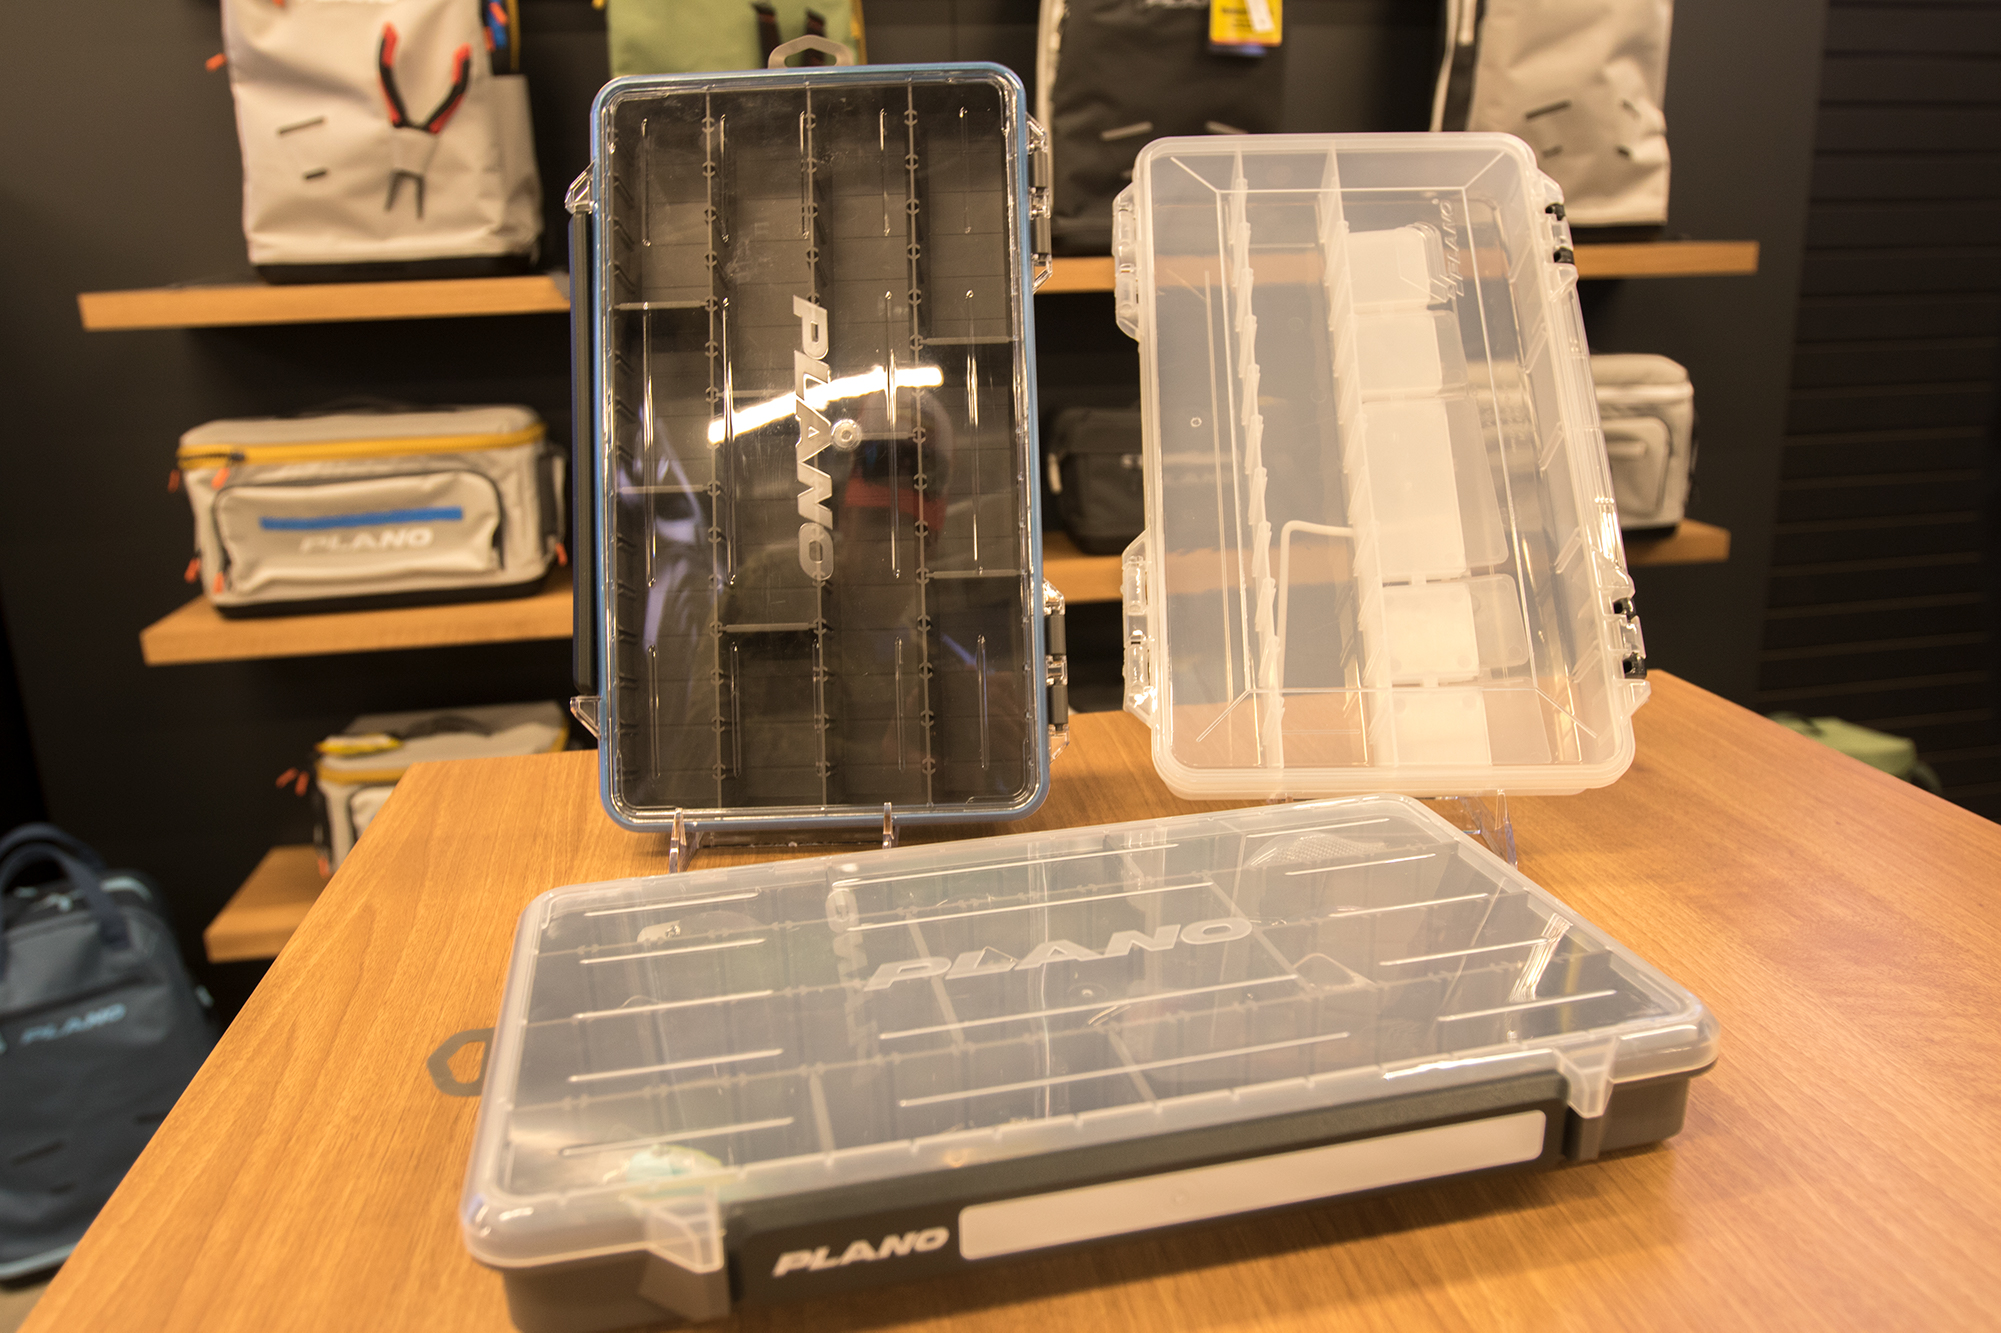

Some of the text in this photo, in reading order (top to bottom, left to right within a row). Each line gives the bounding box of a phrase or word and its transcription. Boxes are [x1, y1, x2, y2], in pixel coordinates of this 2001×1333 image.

[793, 294, 834, 580] PLANO
[300, 527, 434, 554] PLANO
[864, 917, 1253, 992] PLANO
[771, 1226, 949, 1278] PLANO
